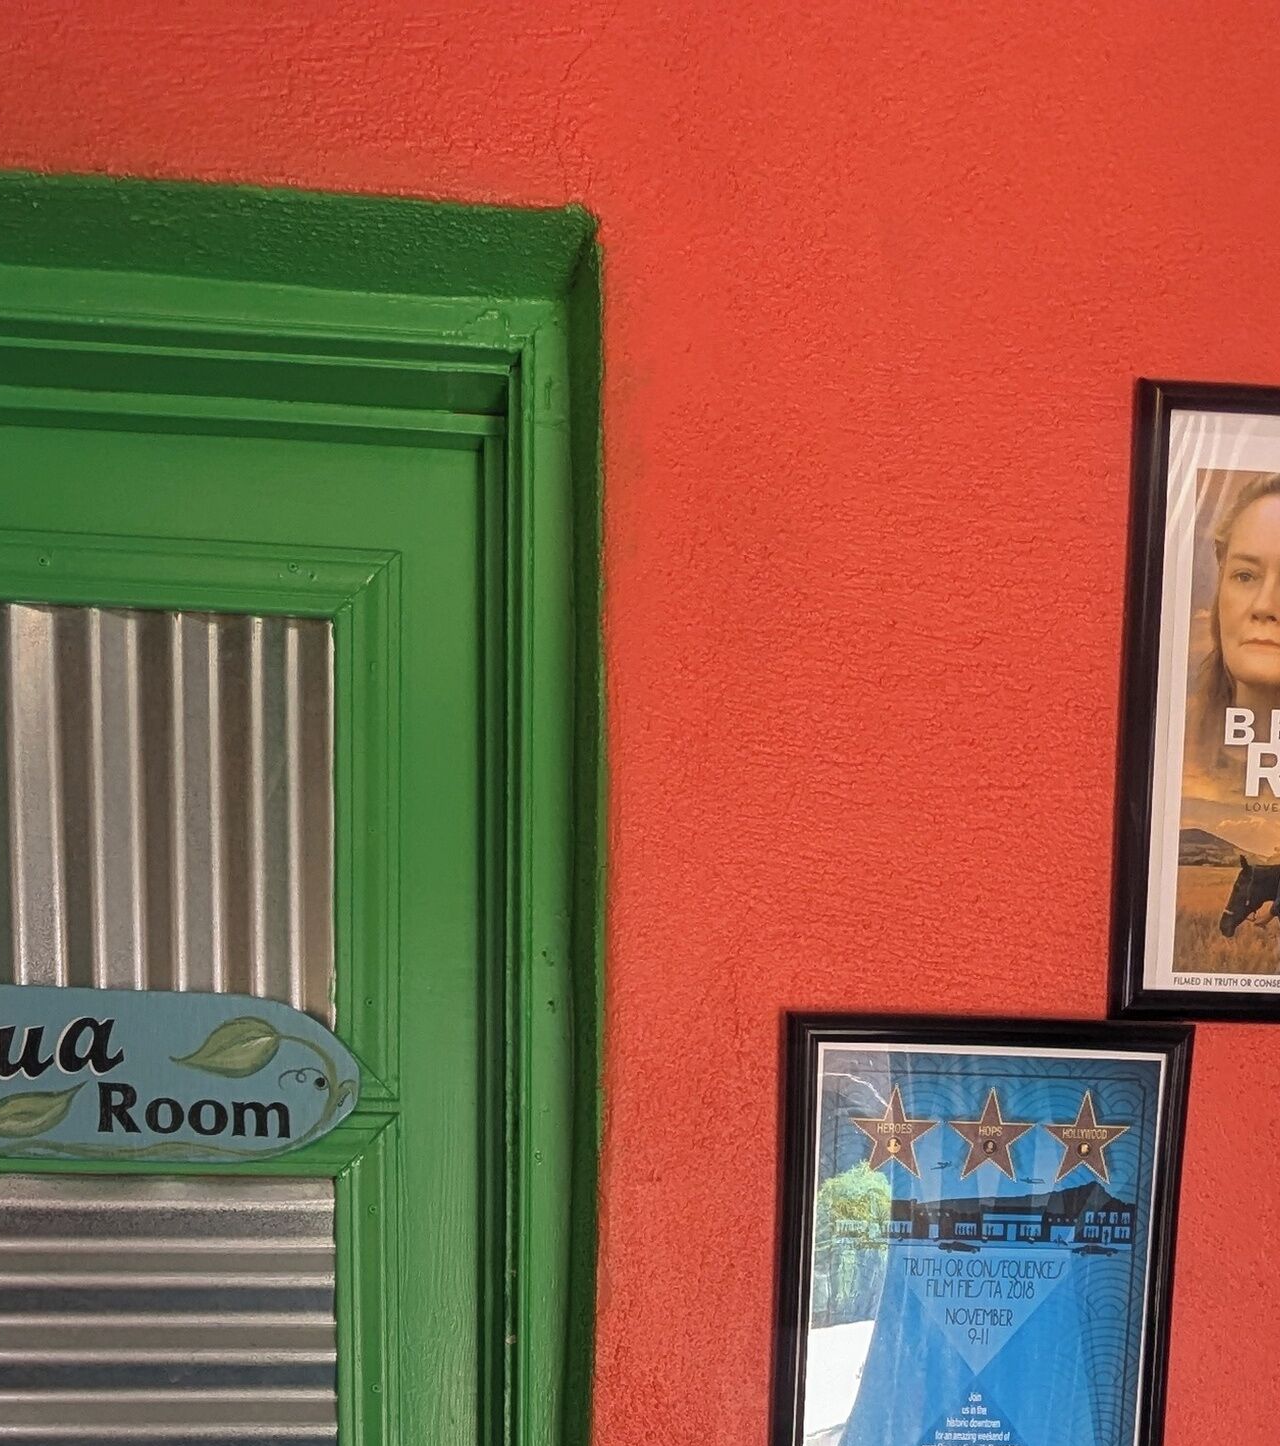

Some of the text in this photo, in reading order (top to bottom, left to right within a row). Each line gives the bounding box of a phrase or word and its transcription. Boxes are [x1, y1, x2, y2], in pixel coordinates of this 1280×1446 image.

[1246, 803, 1278, 813] LOVE
[1173, 977, 1200, 986] FILMED
[1203, 978, 1212, 986] IN
[1215, 978, 1238, 987] TRUTH
[1240, 979, 1252, 987] OR
[97, 1081, 290, 1139] Room
[877, 1123, 913, 1134] HEROES
[979, 1126, 1002, 1137] HOPS
[1062, 1128, 1107, 1139] HOLLYWOOD
[903, 1258, 1066, 1280] TRUTH OR CONSEQUENCES
[926, 1279, 1035, 1299] FILM FIESTA 2018
[945, 1308, 1013, 1326] NOVEMBER
[968, 1328, 989, 1345] 9-11
